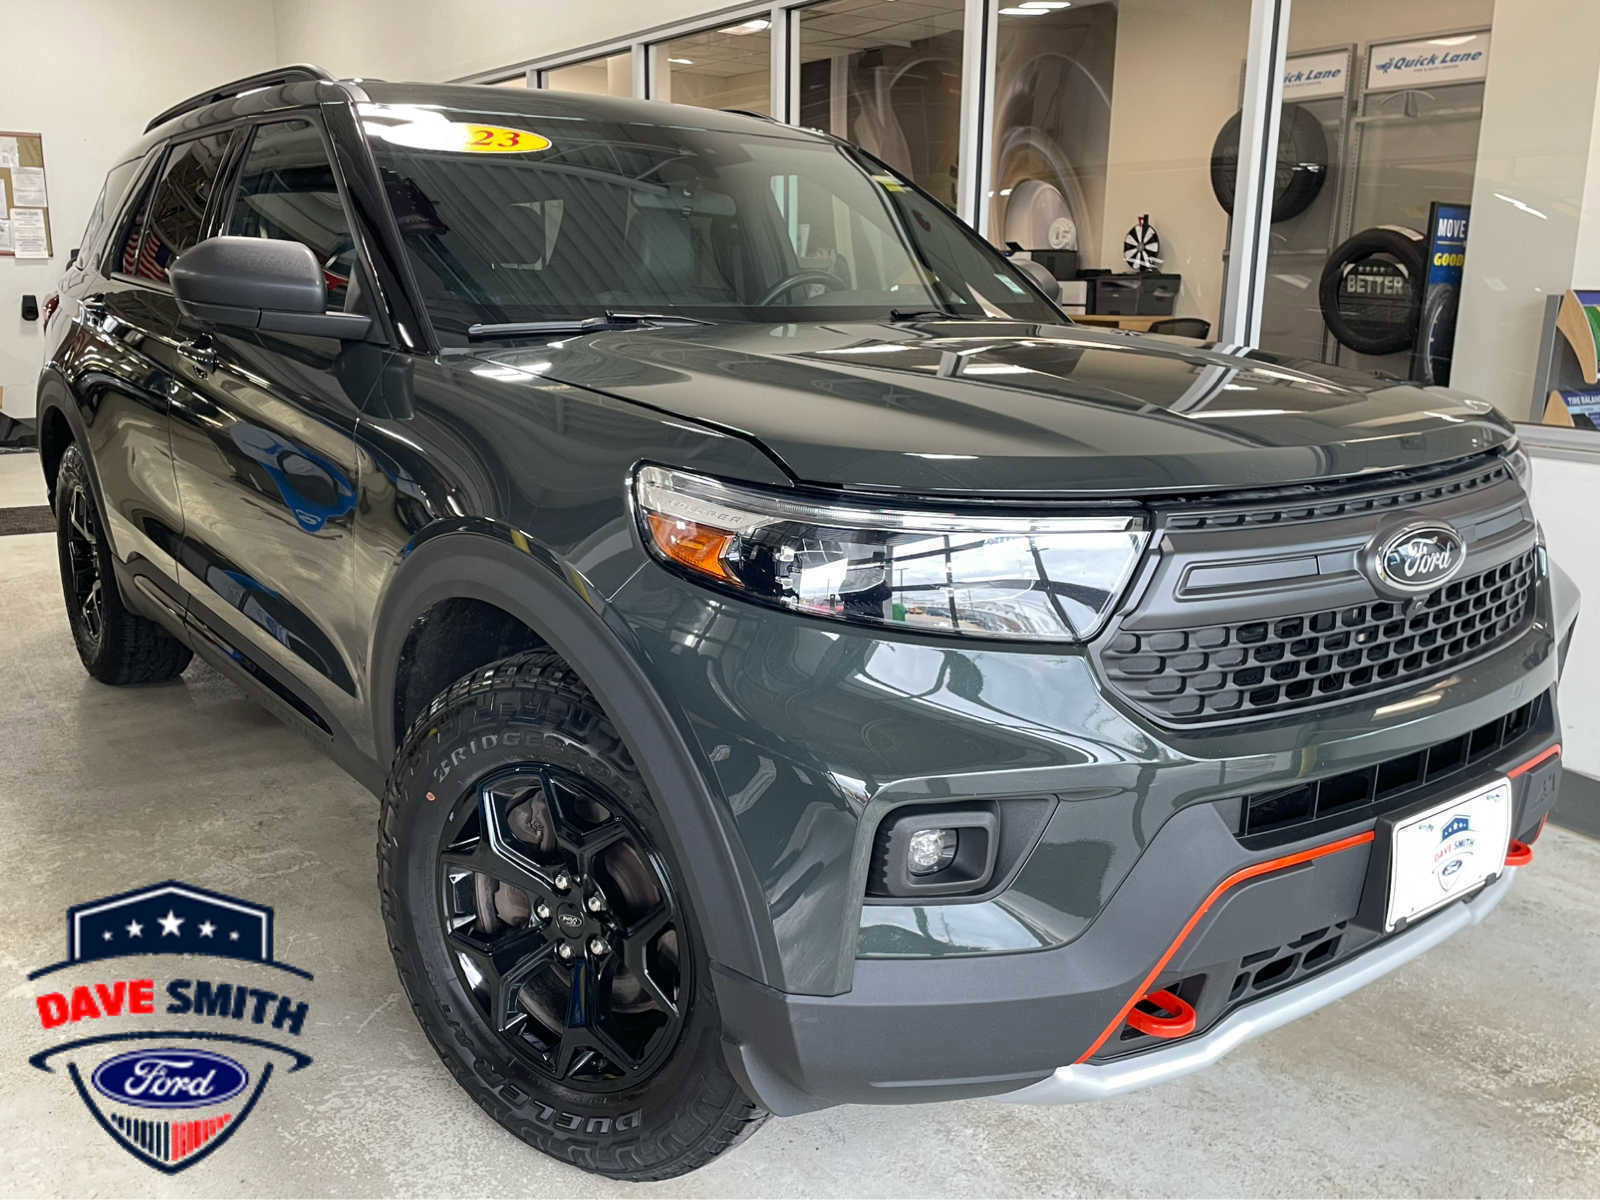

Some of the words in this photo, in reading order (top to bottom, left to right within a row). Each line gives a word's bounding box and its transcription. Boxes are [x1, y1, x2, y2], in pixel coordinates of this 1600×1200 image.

[1393, 54, 1438, 71] Quick
[1440, 50, 1483, 64] Lane
[1283, 71, 1304, 84] ick
[1305, 67, 1342, 81] Lane
[1437, 217, 1467, 238] MOVE
[1346, 274, 1404, 295] BETTER
[1404, 535, 1452, 577] Ford
